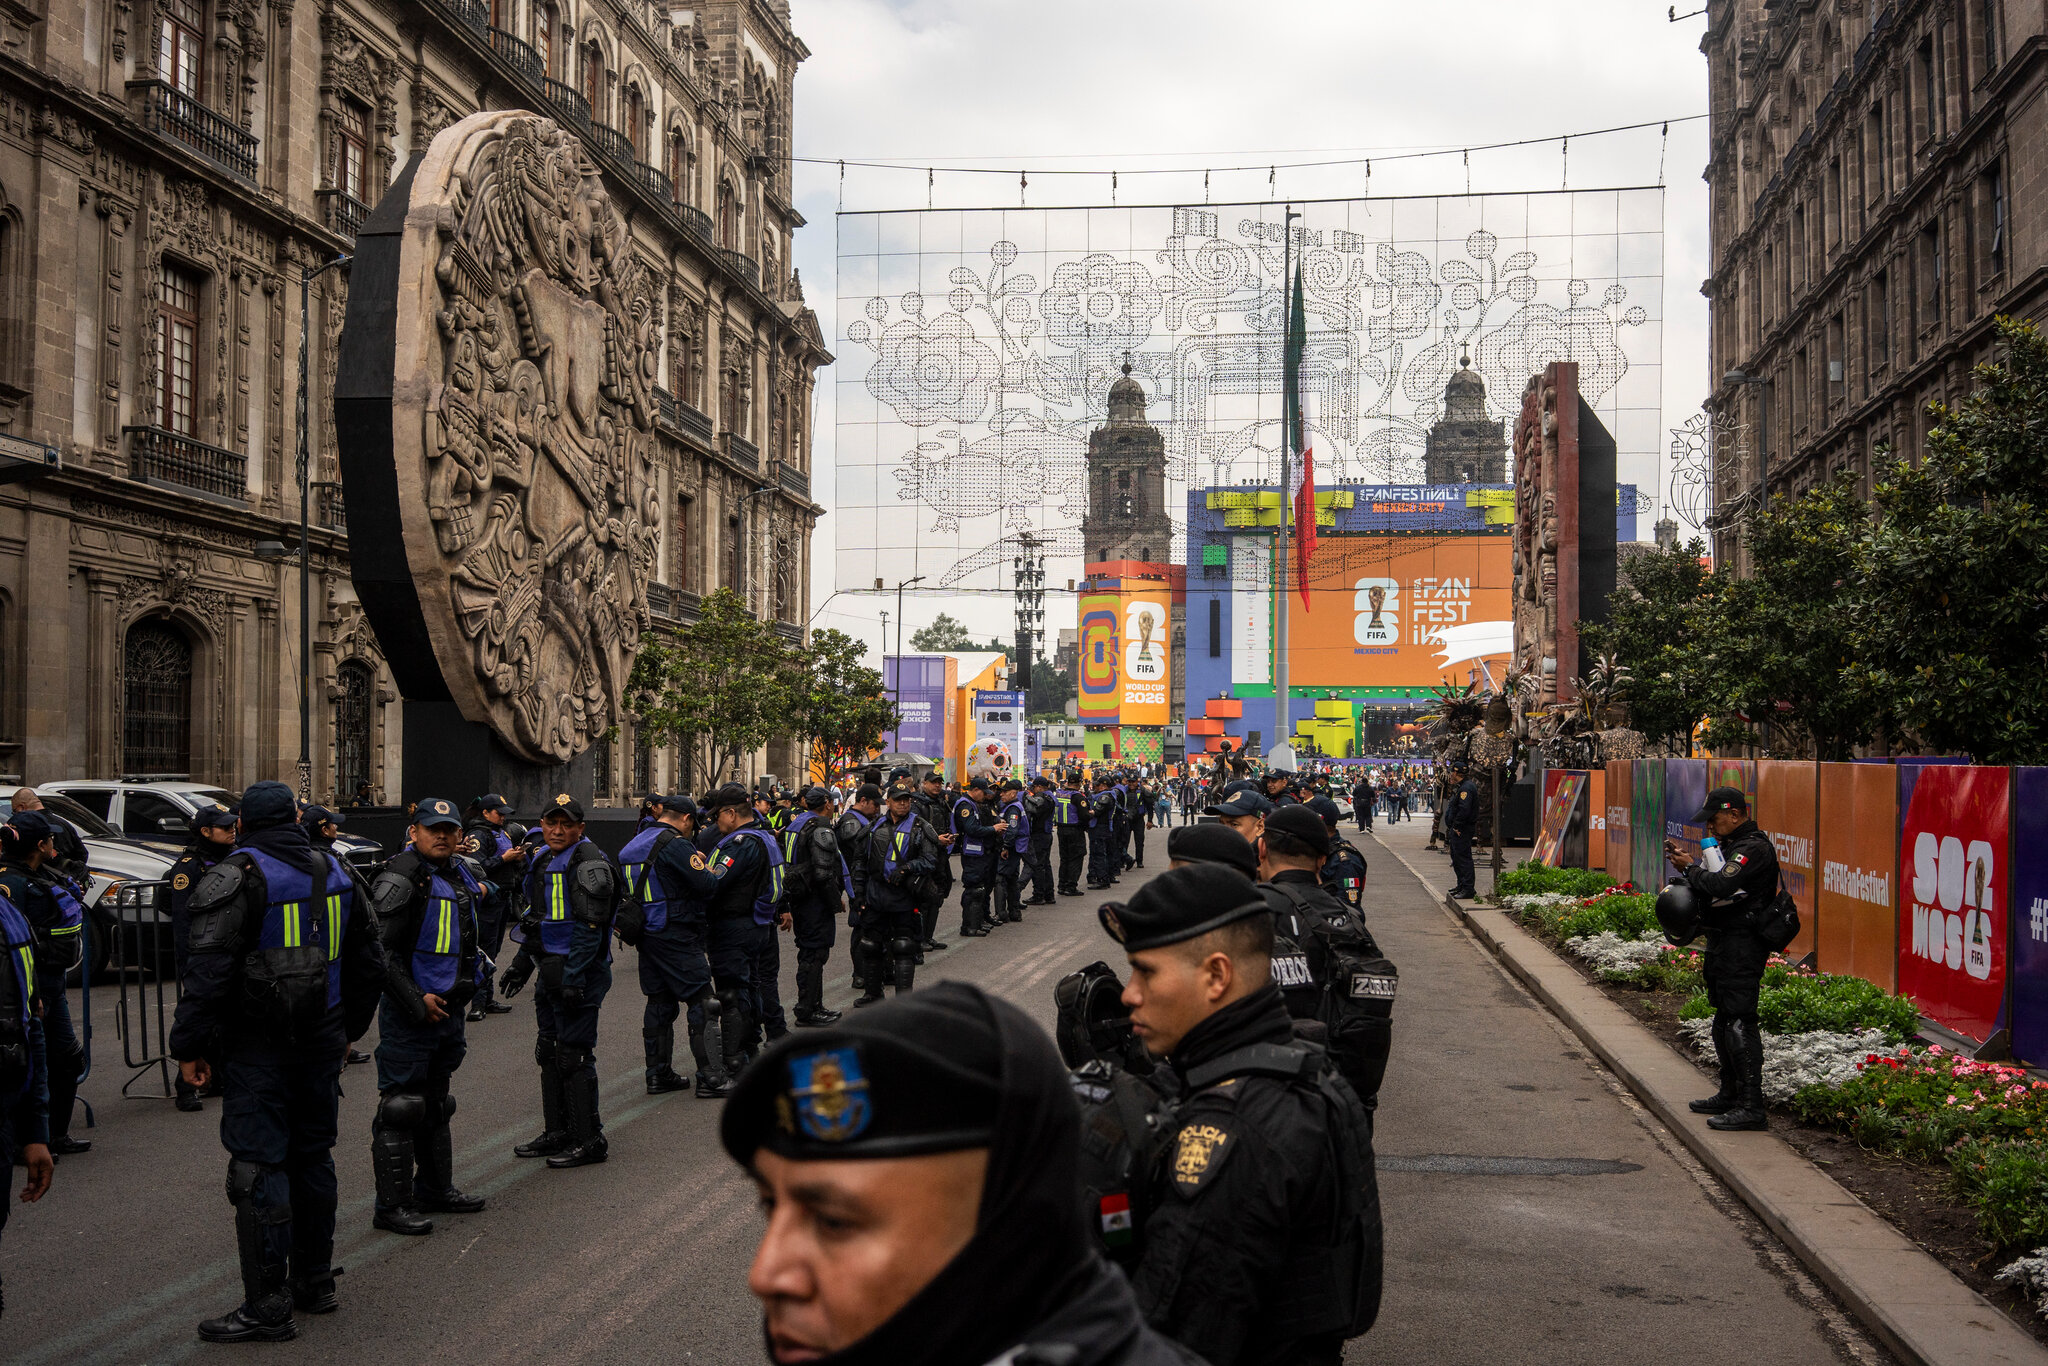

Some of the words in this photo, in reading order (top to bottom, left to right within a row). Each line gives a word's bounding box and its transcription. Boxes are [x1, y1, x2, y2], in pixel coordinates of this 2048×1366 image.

[1372, 502, 1416, 512] MEXICO
[1419, 502, 1445, 512] CITY
[1424, 578, 1470, 598] FAN
[1414, 601, 1471, 621] FEST
[1137, 665, 1154, 673] FIFA
[1126, 683, 1150, 691] WORLD
[1125, 692, 1165, 704] 2026
[987, 712, 1012, 721] 26
[1667, 821, 1682, 837] SOMOS
[1824, 860, 1889, 907] #FIFAFanFestival
[1971, 950, 1984, 967] FIFA
[1271, 956, 1312, 985] ORROS
